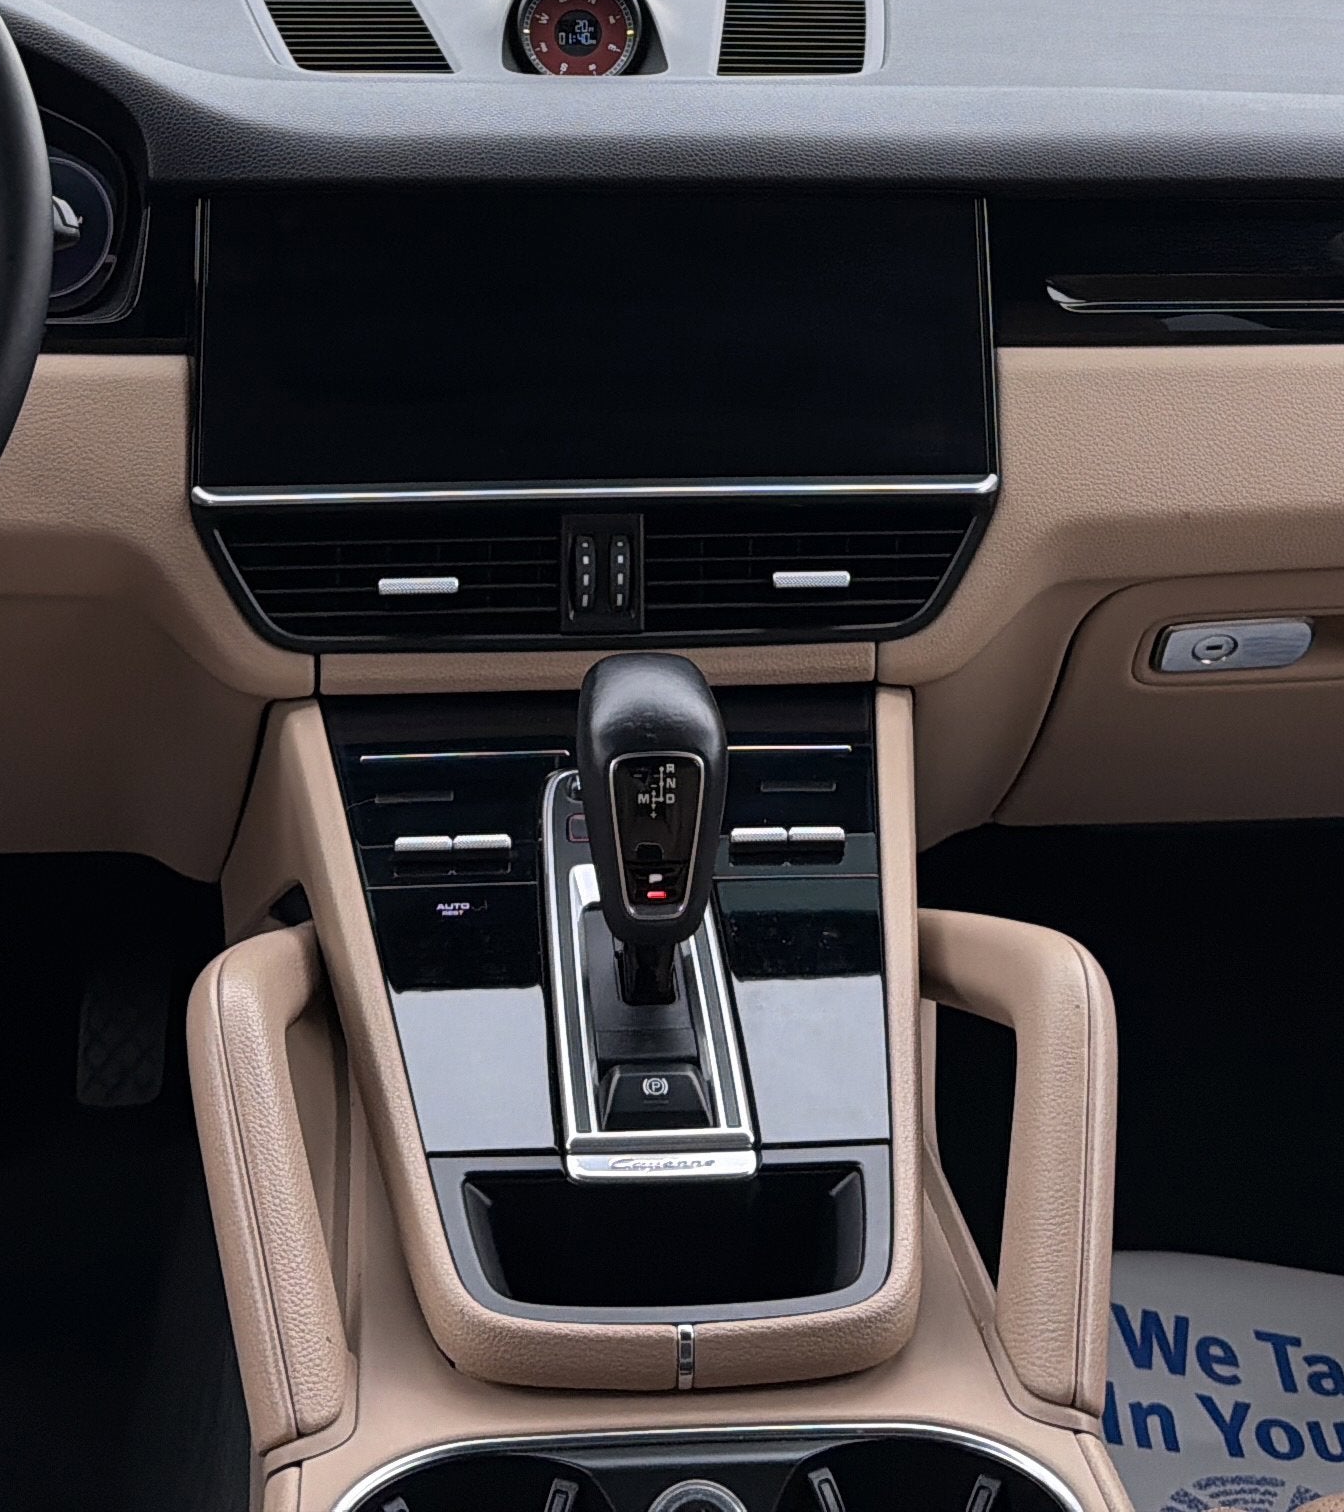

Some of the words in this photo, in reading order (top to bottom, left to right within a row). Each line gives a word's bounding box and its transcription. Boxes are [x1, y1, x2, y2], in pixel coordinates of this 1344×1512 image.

[538, 13, 550, 24] W
[560, 62, 569, 72] S
[666, 764, 675, 773] R
[666, 778, 676, 788] N
[637, 793, 650, 804] M
[666, 794, 675, 804] D
[648, 874, 663, 884] P
[436, 902, 471, 912] AUTO
[610, 1157, 717, 1175] Cayenne
[1111, 1302, 1242, 1386] We
[1102, 1381, 1181, 1454] In
